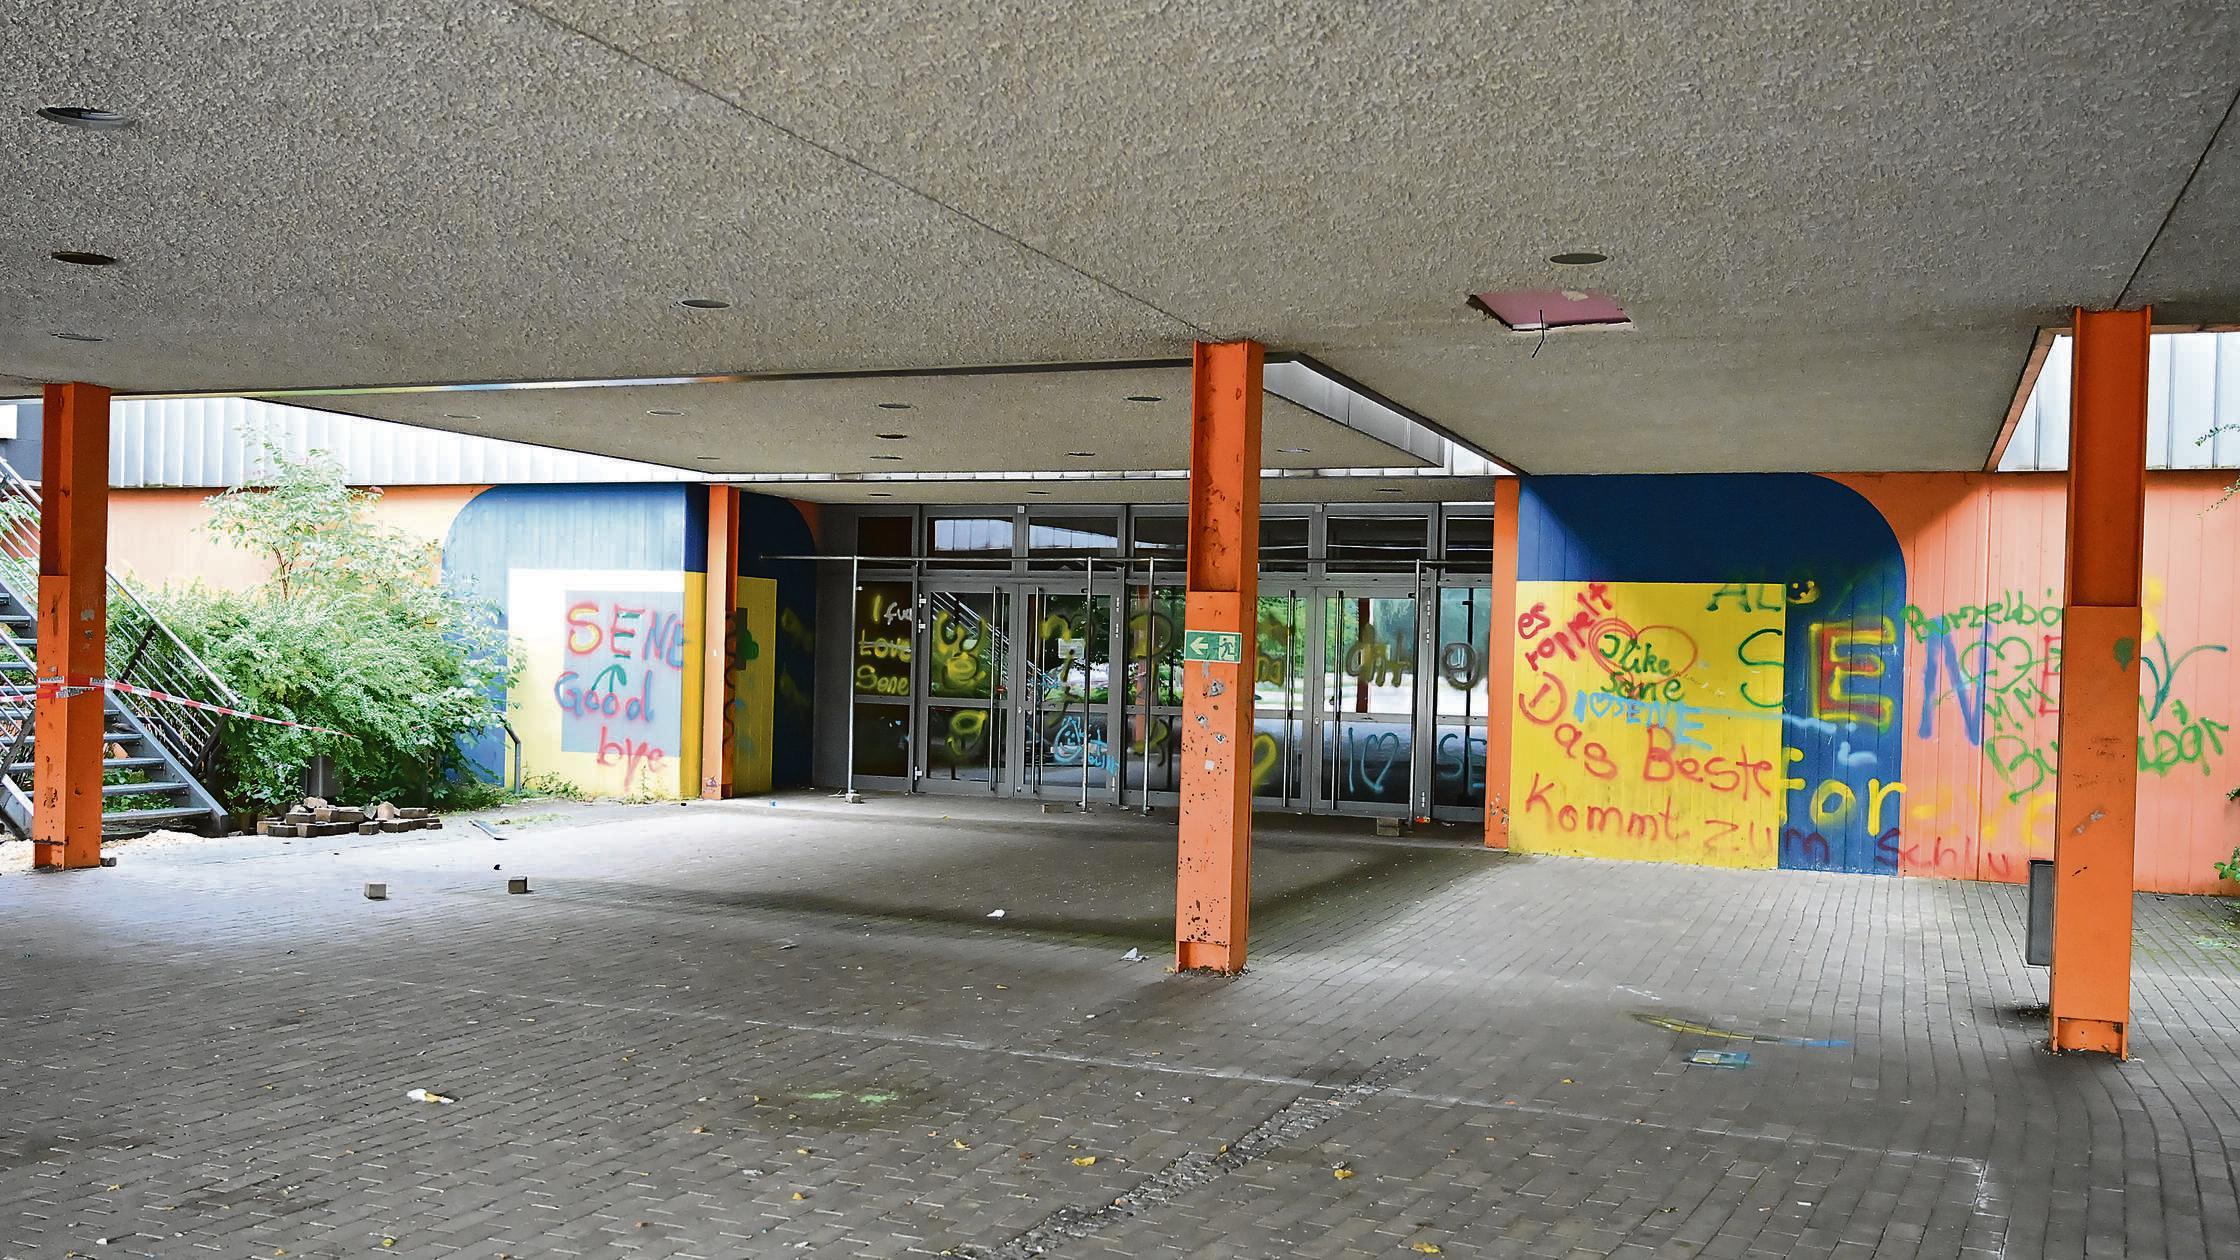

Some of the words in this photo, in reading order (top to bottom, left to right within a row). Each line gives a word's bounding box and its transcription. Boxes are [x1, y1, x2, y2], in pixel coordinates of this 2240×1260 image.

[555, 670, 655, 723] Good
[597, 726, 668, 792] bye
[1525, 772, 1682, 842] Kommt
